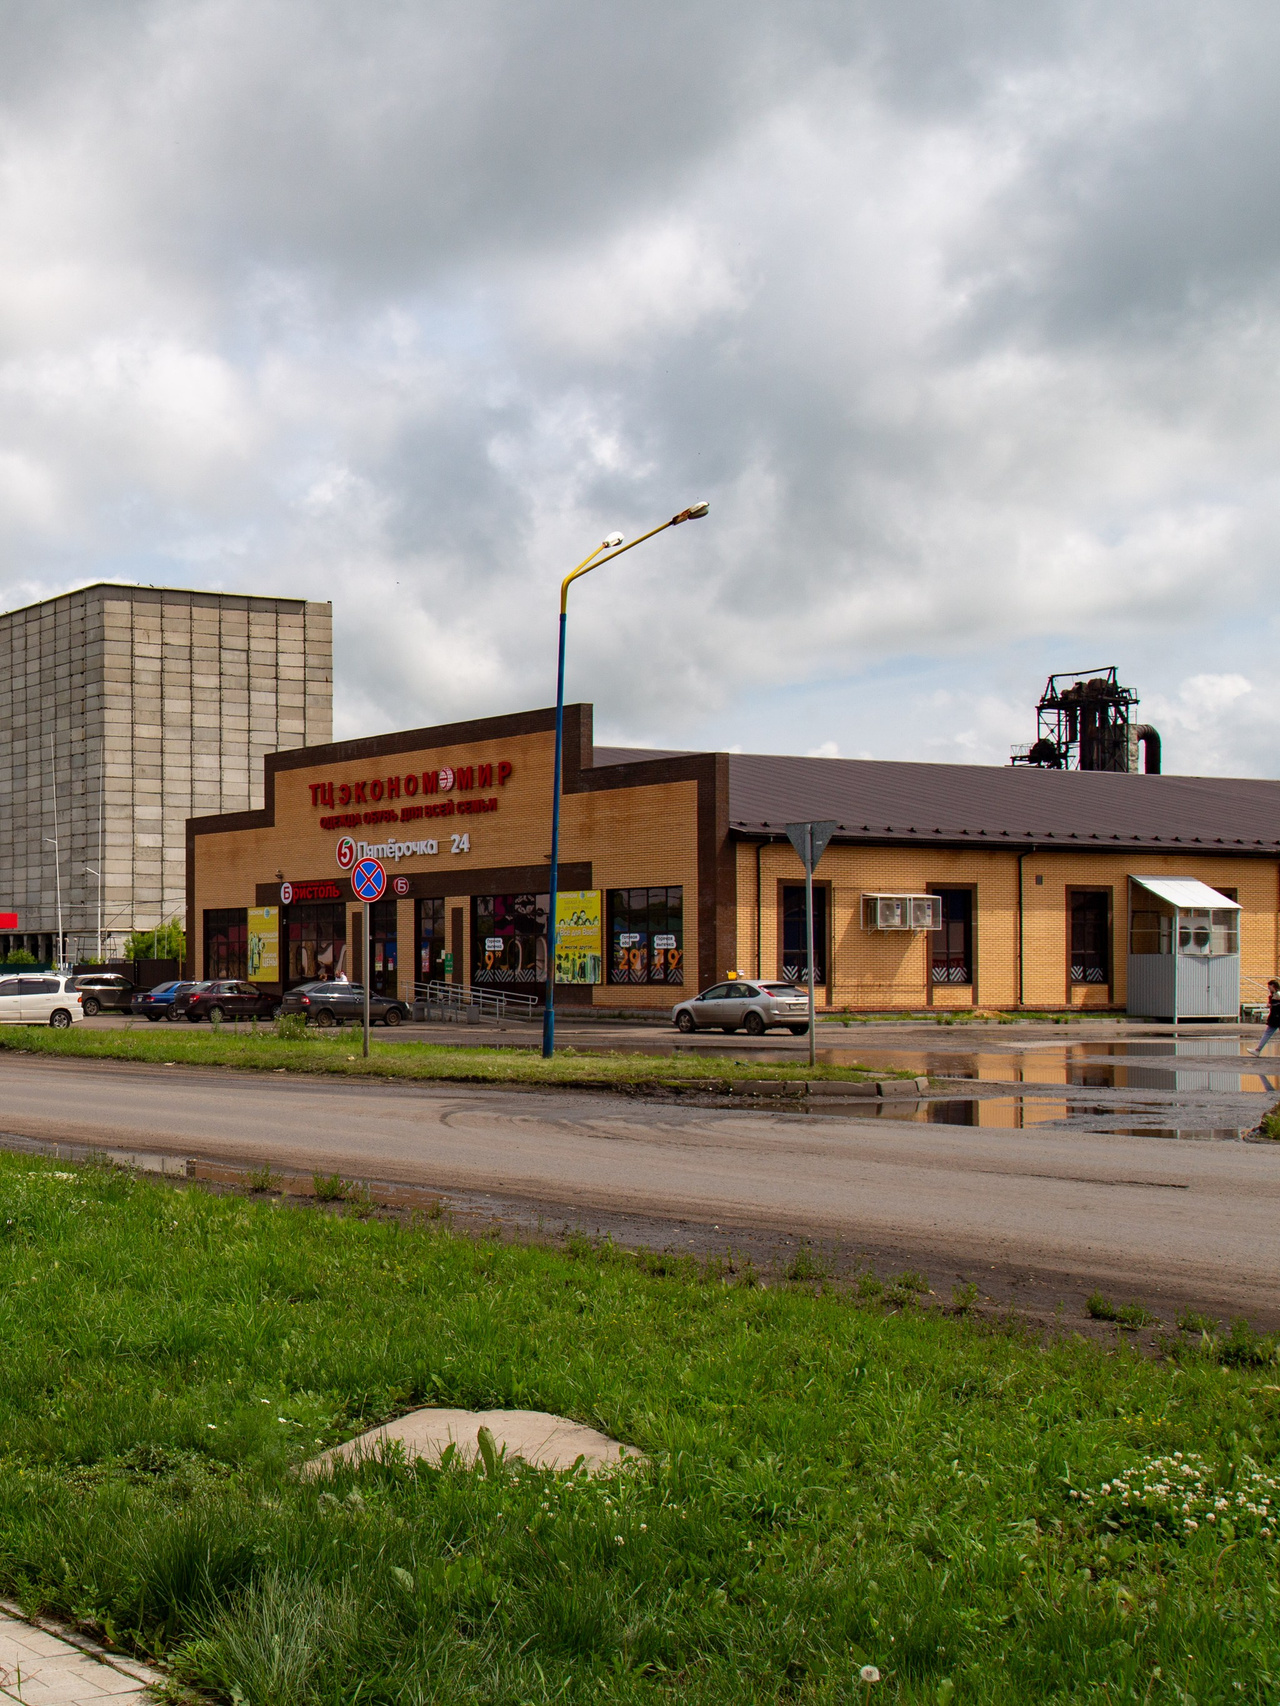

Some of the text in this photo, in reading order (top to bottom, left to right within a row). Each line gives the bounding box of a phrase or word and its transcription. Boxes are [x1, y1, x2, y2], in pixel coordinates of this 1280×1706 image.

[308, 781, 335, 809] ТЦ
[456, 761, 512, 791] МИР
[320, 797, 498, 830] ОДЕЖДА ОБУВЬ ДЛЯ ВСЕЙ СЕМЬИ
[357, 838, 439, 861] Пятёрочка
[450, 833, 471, 853] 24
